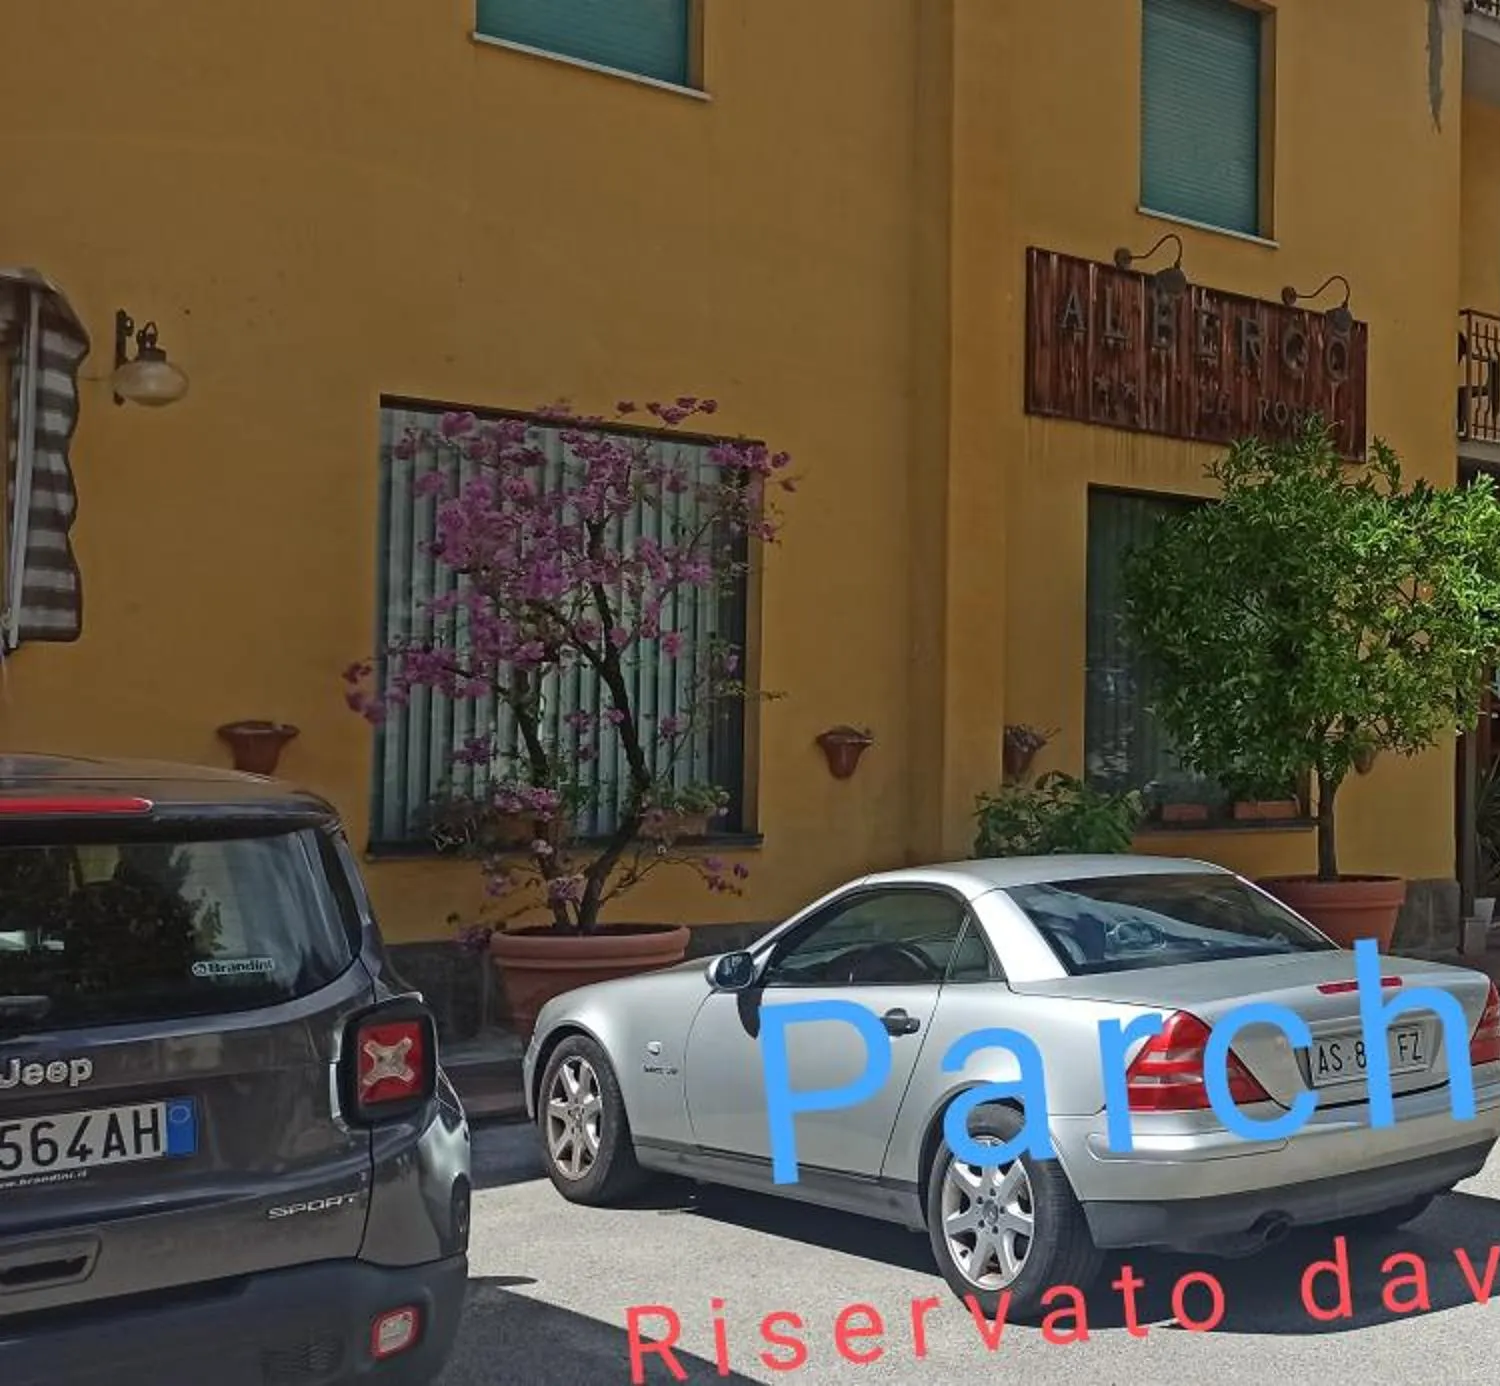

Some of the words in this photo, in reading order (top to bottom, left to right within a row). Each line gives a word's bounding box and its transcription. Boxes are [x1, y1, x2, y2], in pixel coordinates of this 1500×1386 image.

[1060, 284, 1349, 383] ALBERGO
[1319, 1043, 1343, 1074] AS
[1397, 1031, 1422, 1062] FZ
[0, 1057, 93, 1089] Jeep
[268, 1192, 359, 1219] SPORT
